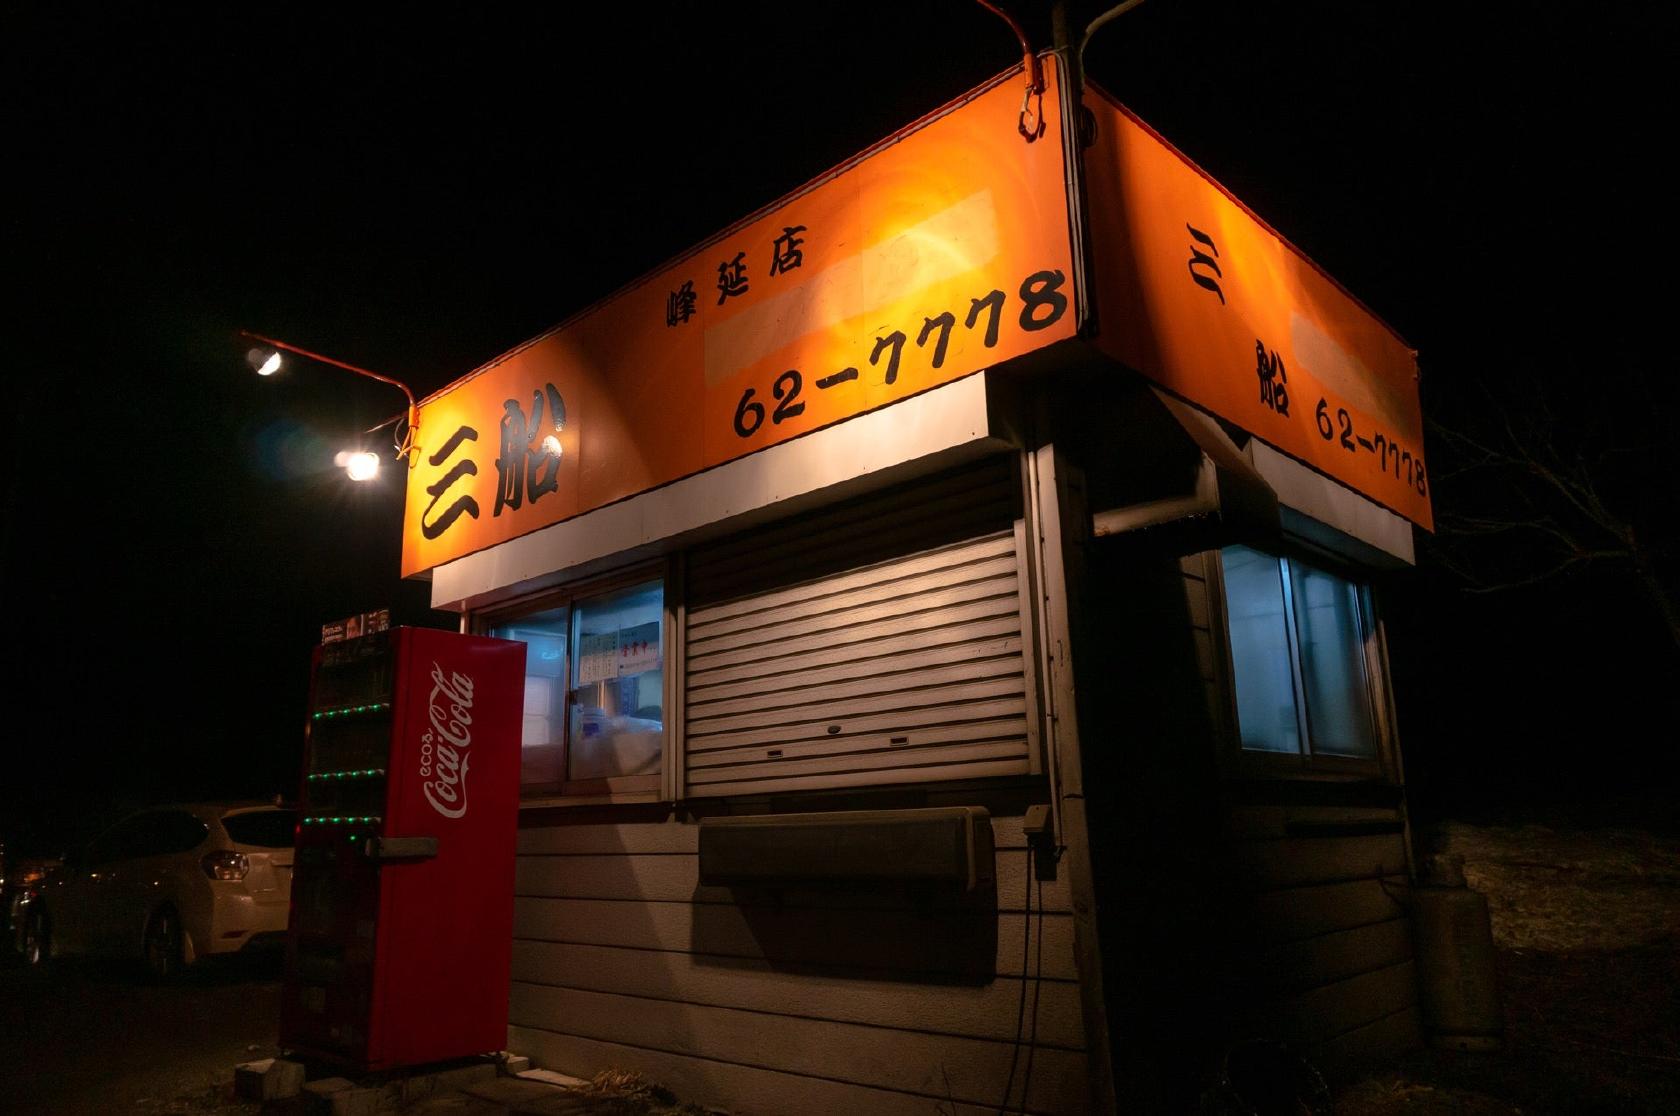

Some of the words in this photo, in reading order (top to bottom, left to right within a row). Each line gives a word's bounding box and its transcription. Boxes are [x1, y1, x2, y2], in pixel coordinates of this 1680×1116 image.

[667, 224, 808, 328] 峰延店
[735, 269, 1068, 438] 62-7778
[422, 382, 566, 540] 三船
[1315, 398, 1426, 496] 62-7778
